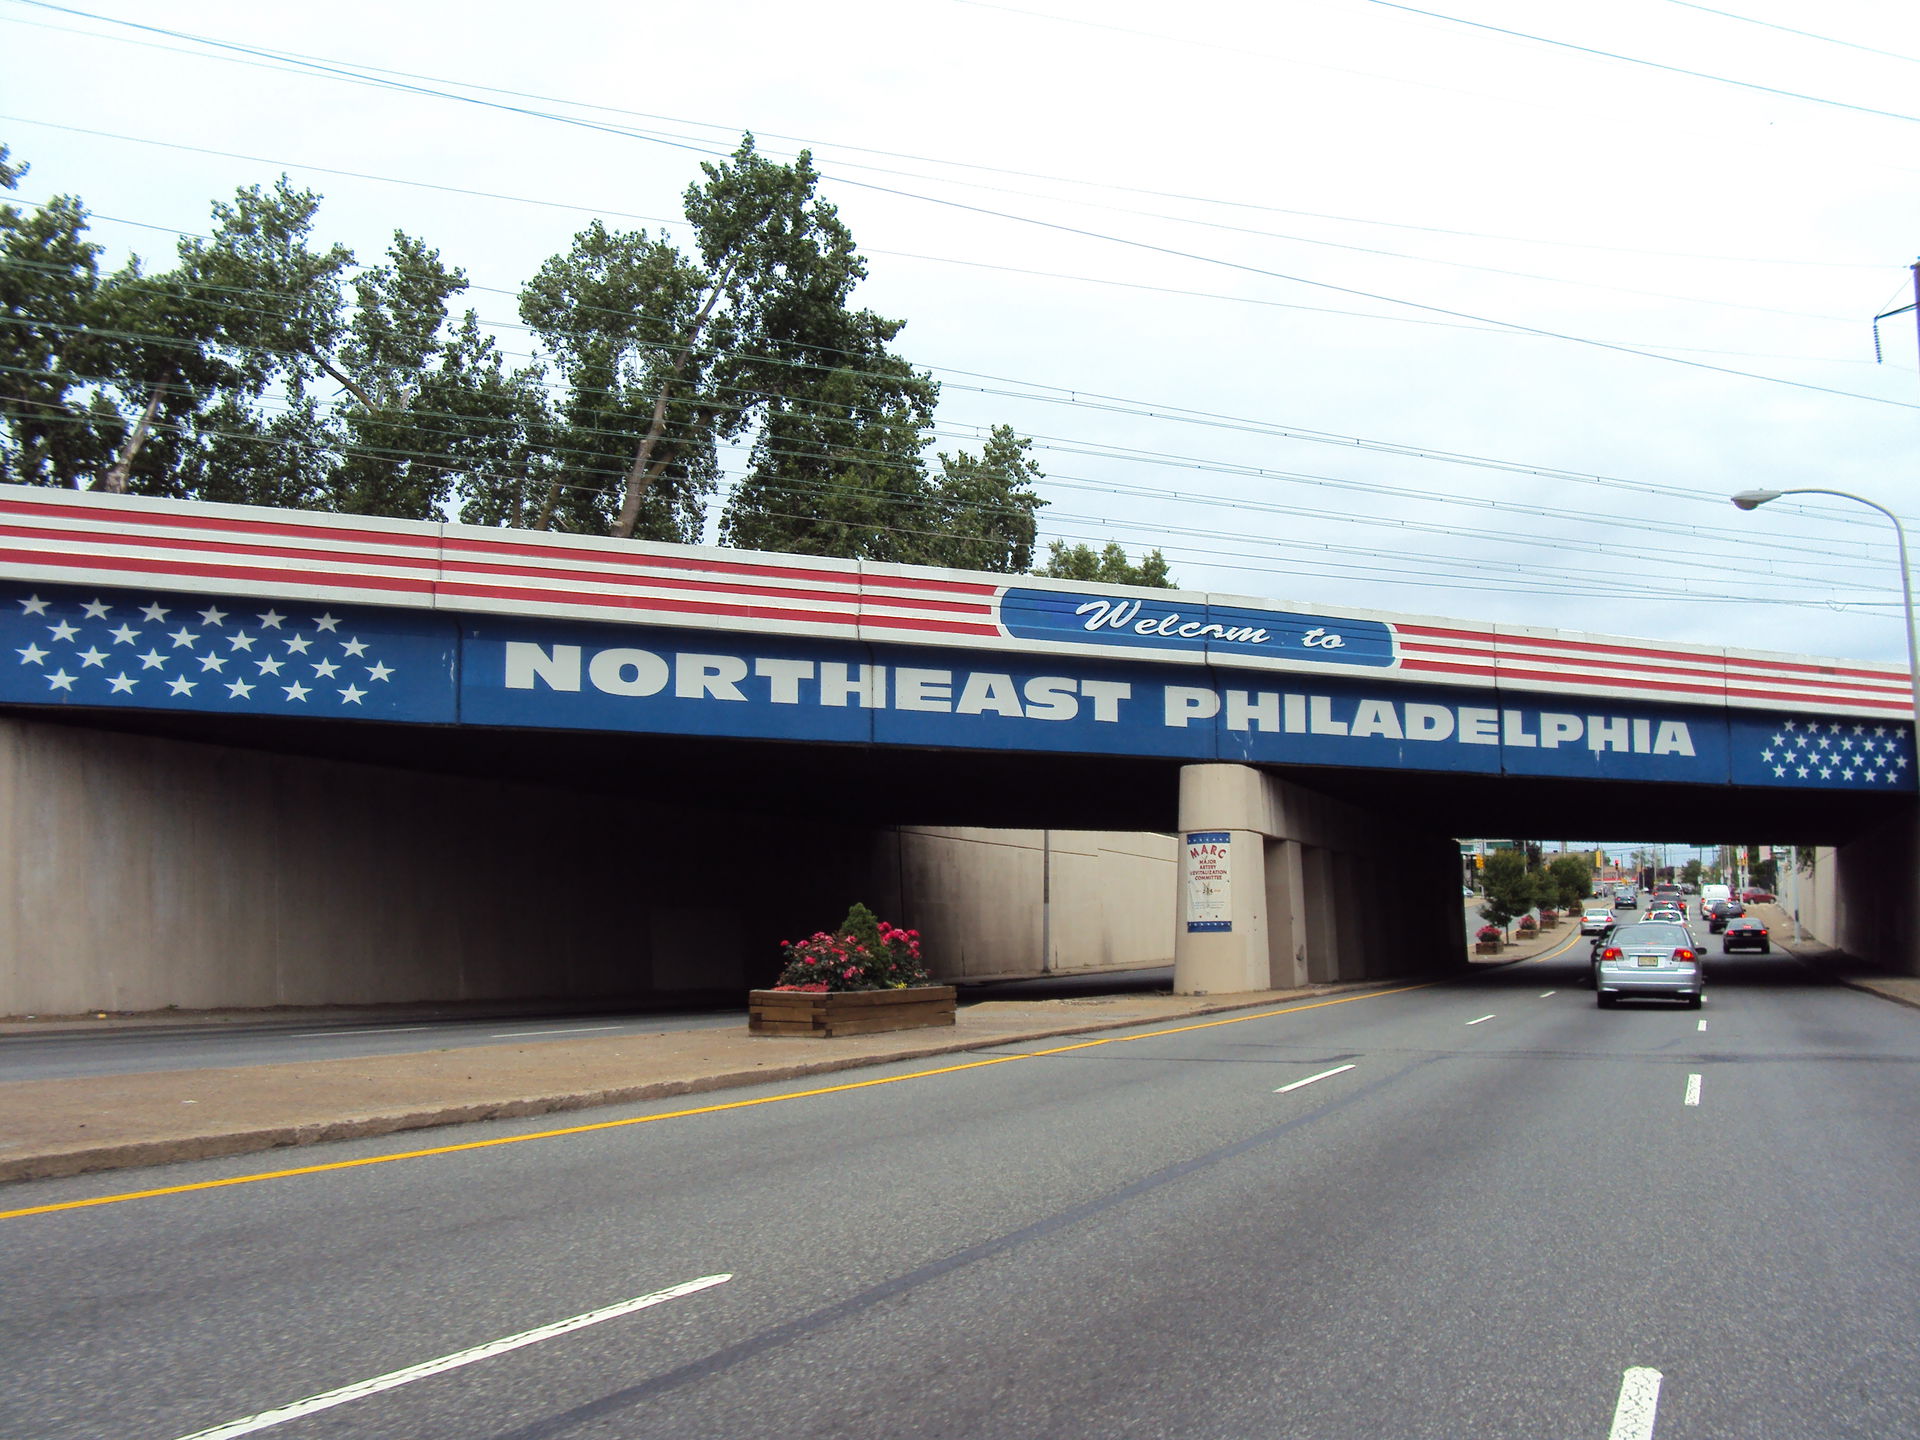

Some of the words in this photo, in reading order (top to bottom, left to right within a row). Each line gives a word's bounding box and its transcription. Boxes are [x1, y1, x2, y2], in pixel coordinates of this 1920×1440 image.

[1301, 627, 1346, 650] to
[505, 640, 1132, 724] NORTHEAST
[1164, 685, 1697, 758] PHILADELPHIA
[1190, 844, 1227, 859] MARC
